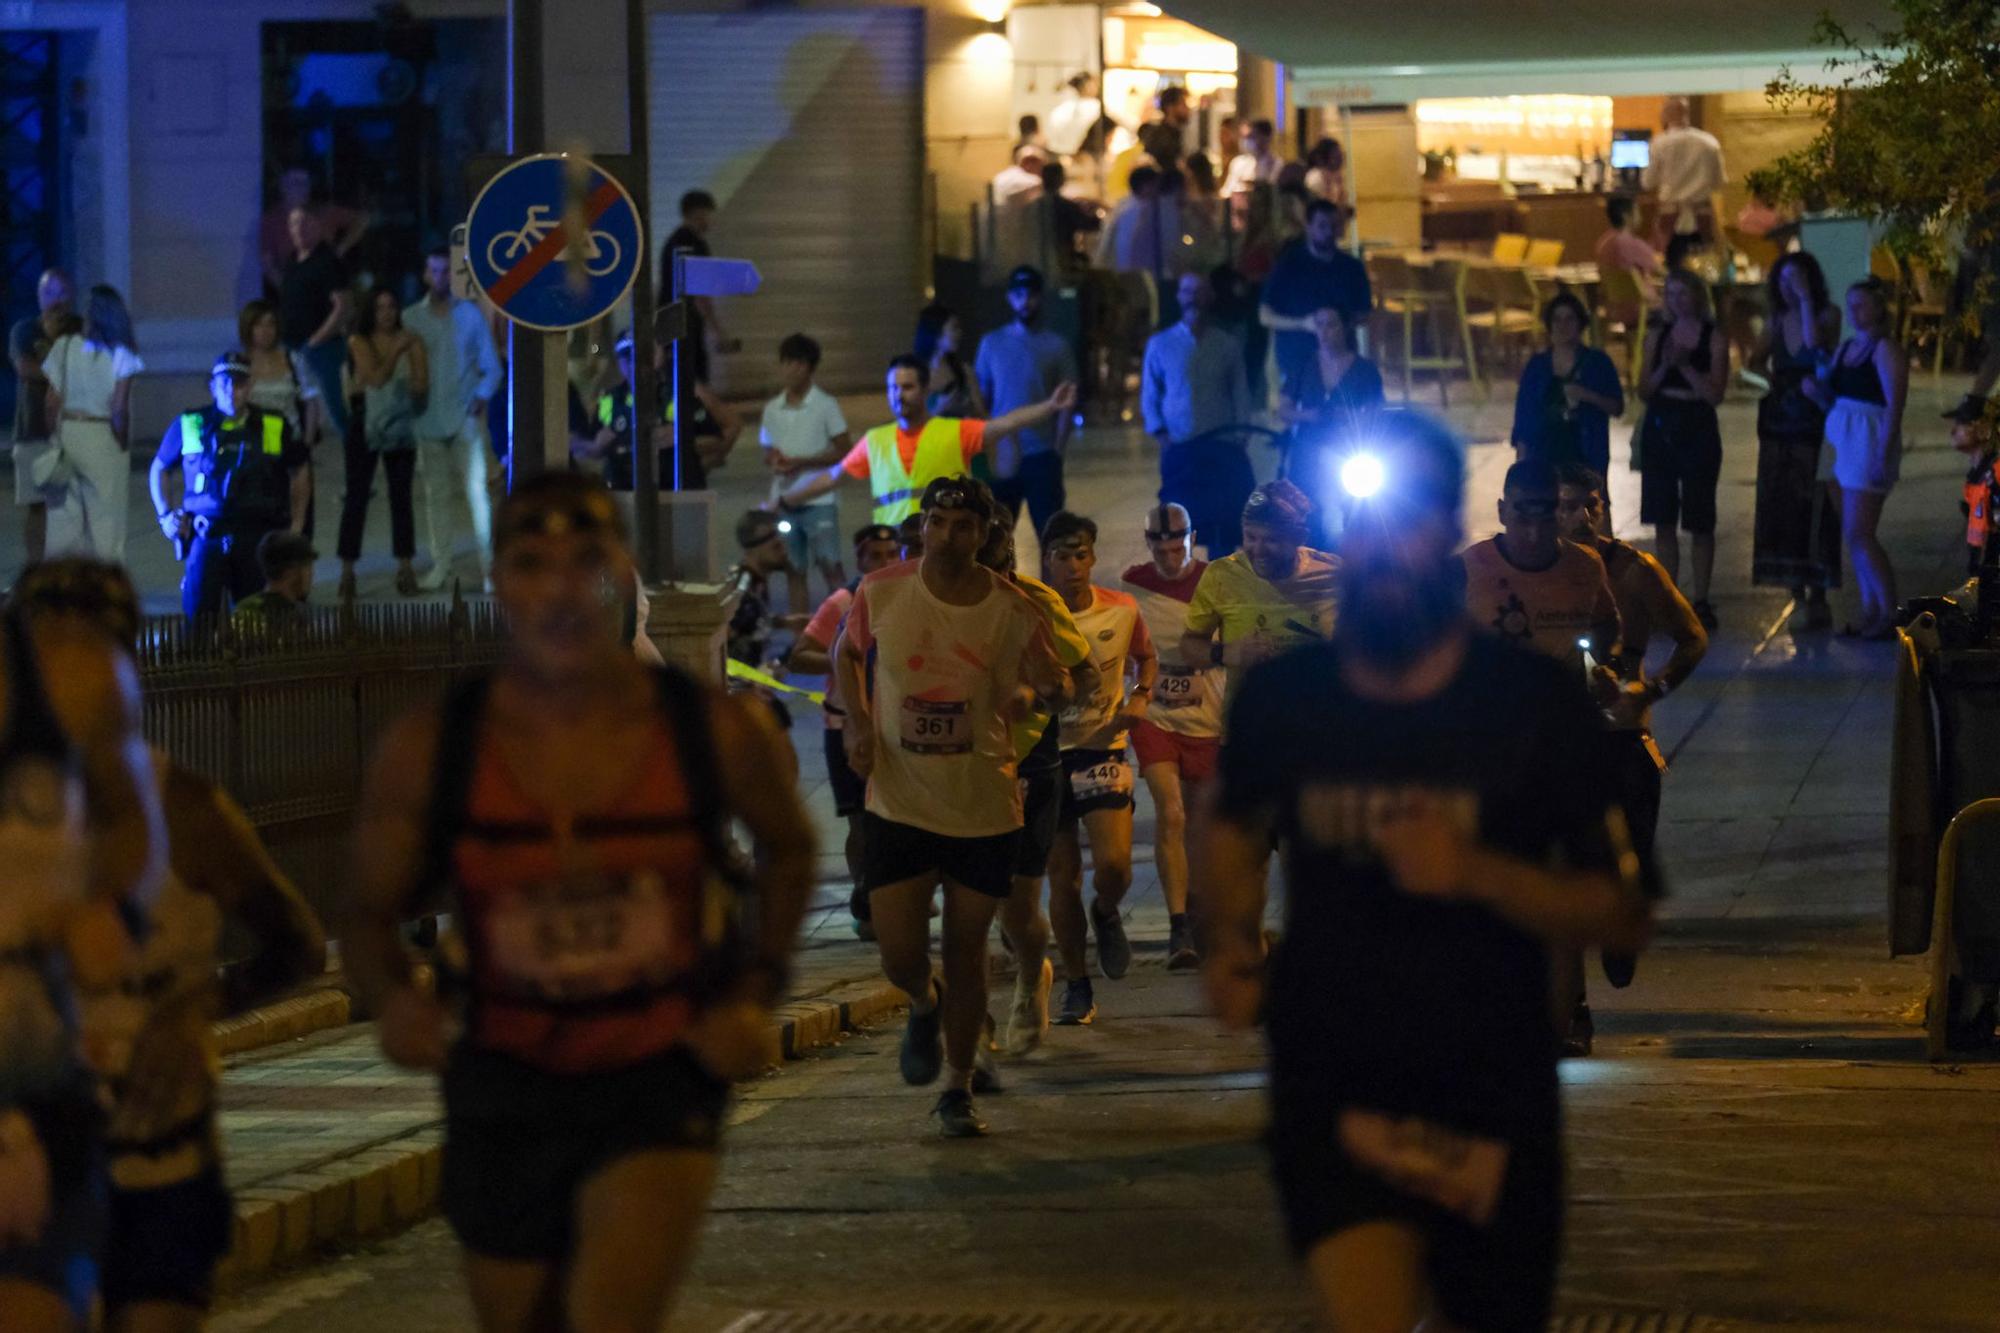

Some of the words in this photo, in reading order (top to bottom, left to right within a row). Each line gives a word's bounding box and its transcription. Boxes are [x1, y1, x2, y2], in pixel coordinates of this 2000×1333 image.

[1161, 678, 1190, 693] 429
[915, 717, 954, 735] 361
[1086, 765, 1120, 780] 440
